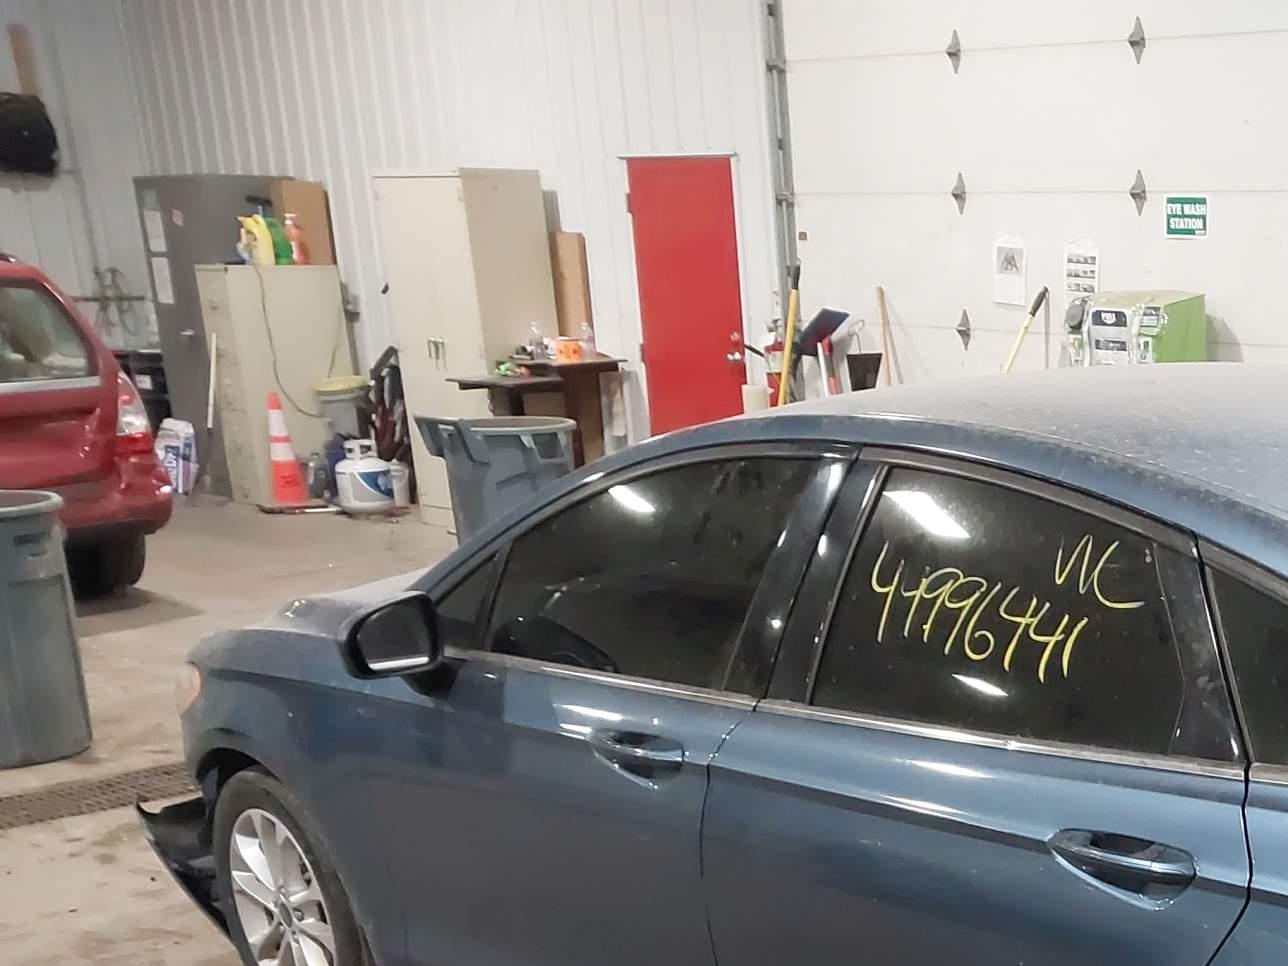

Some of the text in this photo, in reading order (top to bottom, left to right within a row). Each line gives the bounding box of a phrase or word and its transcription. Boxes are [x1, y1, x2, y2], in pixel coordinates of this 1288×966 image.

[1167, 203, 1183, 215] EYE
[1169, 217, 1204, 230] STATION
[871, 539, 1089, 684] 44996441
